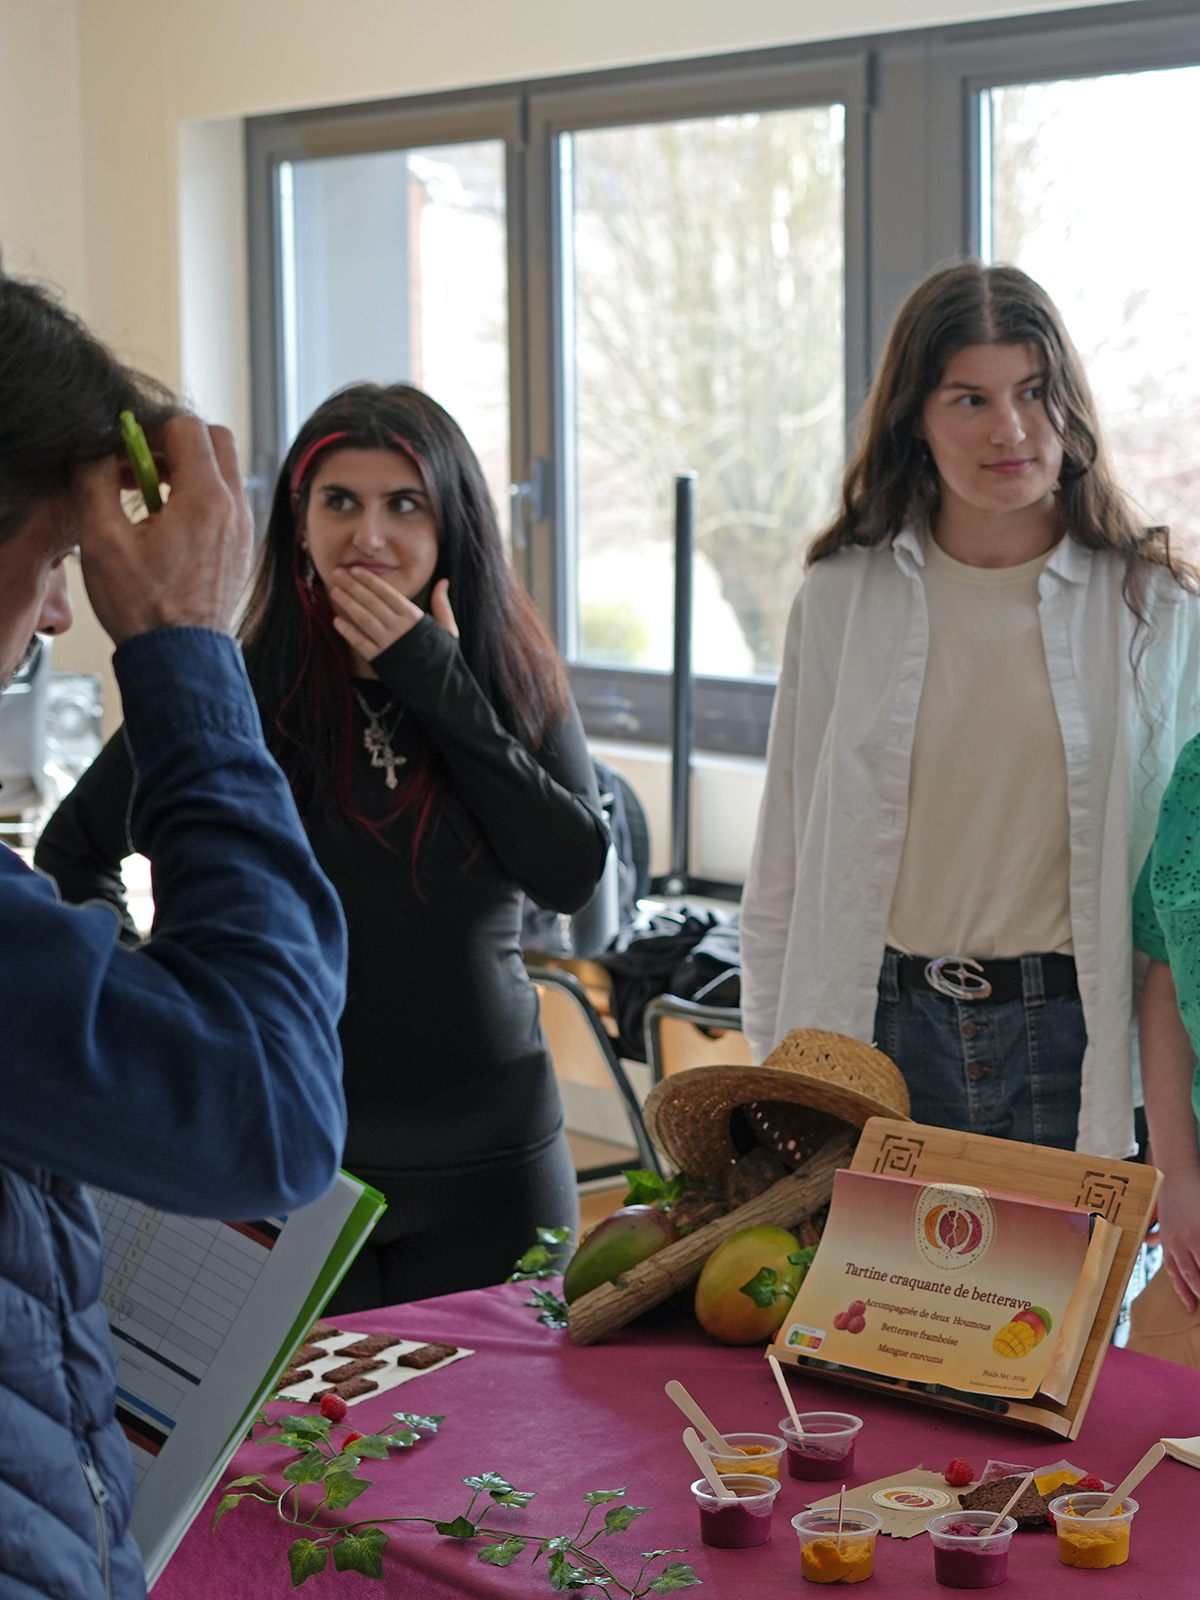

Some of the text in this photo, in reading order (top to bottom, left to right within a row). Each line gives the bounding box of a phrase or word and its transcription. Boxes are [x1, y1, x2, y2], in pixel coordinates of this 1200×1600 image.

[845, 1262, 1032, 1311] Tartine craquante de betterave
[865, 1298, 991, 1331] Accompagnée de deux Houmous
[880, 1323, 959, 1346] Betterave framboise
[877, 1343, 944, 1365] Mangue curcuma
